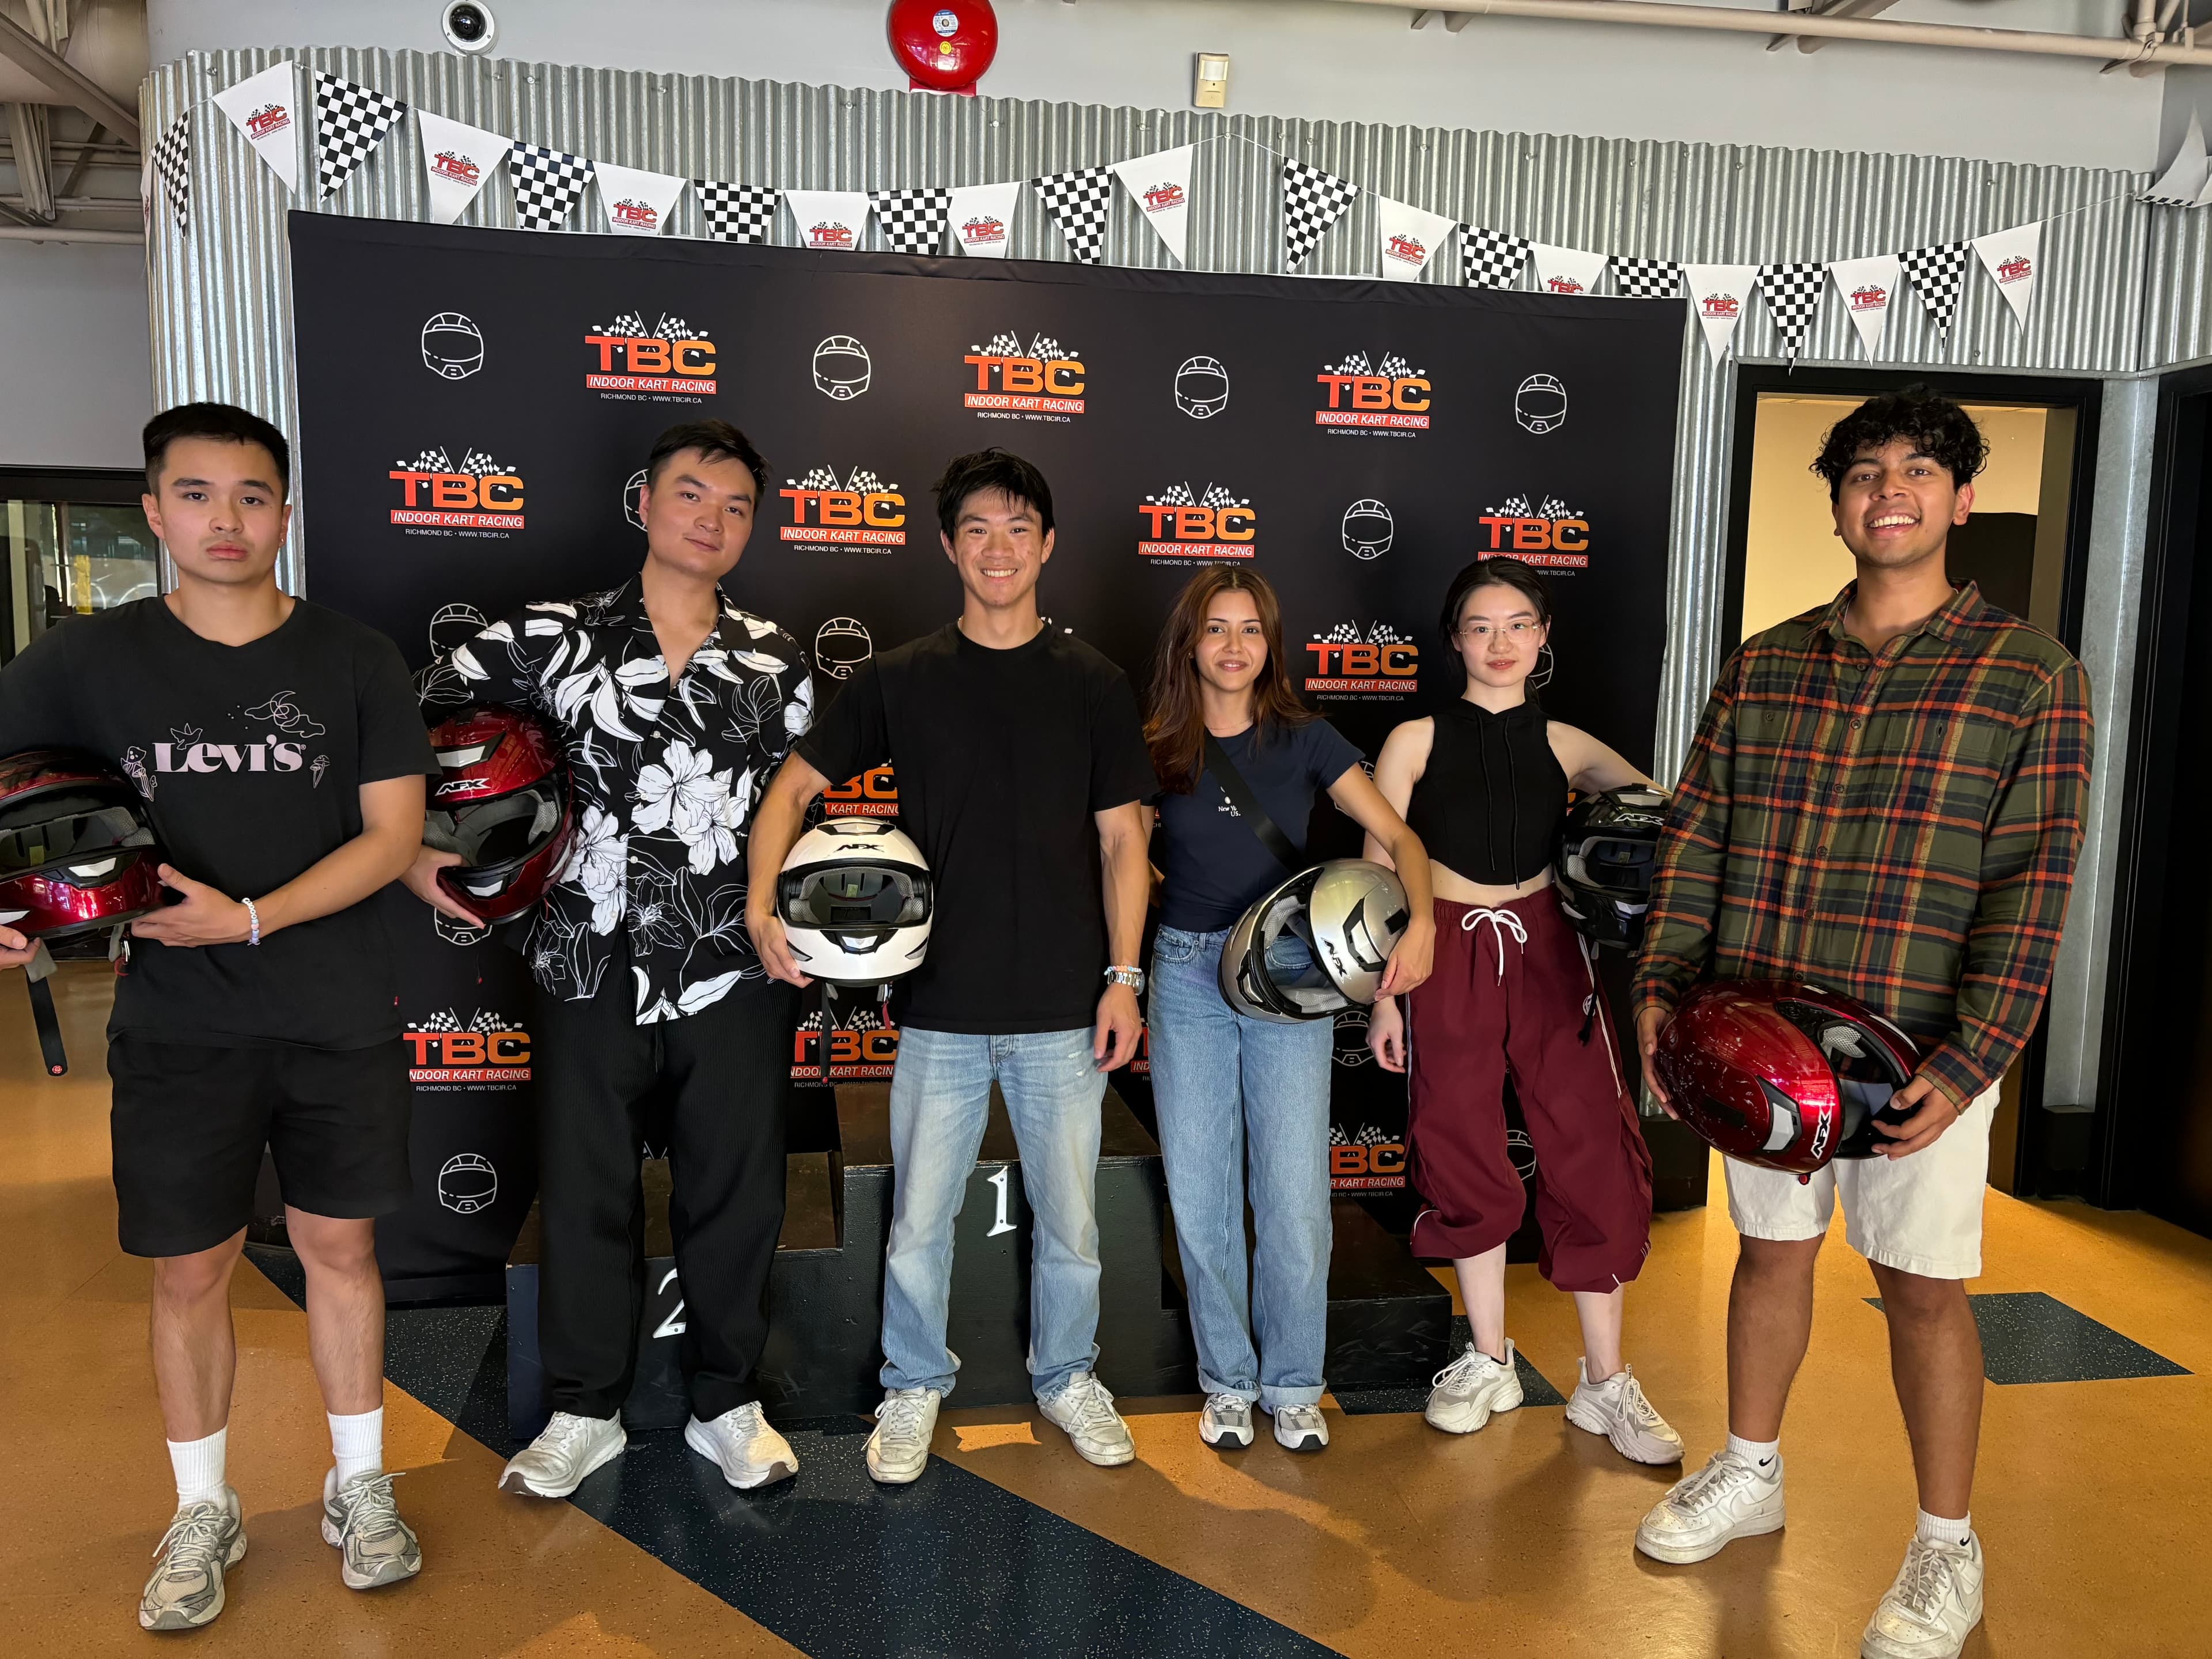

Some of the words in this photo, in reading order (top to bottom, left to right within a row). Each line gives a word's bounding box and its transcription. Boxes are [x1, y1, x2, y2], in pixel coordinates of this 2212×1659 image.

[246, 106, 287, 132] TBC
[434, 154, 479, 180] TBC
[1143, 187, 1183, 205] TBC
[613, 204, 657, 224] TBC
[809, 229, 852, 242] TBC
[962, 222, 1004, 237] TBC
[1389, 237, 1425, 259] TBC
[1997, 260, 2031, 277] TBC
[1850, 290, 1886, 304] TBC
[1703, 300, 1738, 312] TBC
[585, 336, 715, 376] TBC
[964, 355, 1085, 395] TBC
[589, 377, 634, 388] INDOOR
[638, 379, 668, 389] KART
[671, 381, 714, 392] RACING
[1317, 374, 1431, 411] TBC
[968, 396, 1009, 407] INDOOR
[1012, 397, 1041, 408] KART
[1043, 400, 1083, 411] RACING
[1025, 415, 1070, 423] WWW.TBCIR.CA
[1319, 413, 1358, 424] INDOOR
[1361, 415, 1388, 425] KART
[1390, 416, 1428, 426] RACING
[389, 471, 524, 510] TBC
[780, 488, 906, 527] TBC
[394, 512, 440, 523] INDOOR
[444, 514, 475, 525] KART
[478, 516, 522, 527] RACING
[1139, 505, 1256, 540] TBC
[783, 529, 827, 540] INDOOR
[830, 531, 860, 541] KART
[862, 532, 903, 543] RACING
[1479, 517, 1589, 551] TBC
[1141, 544, 1181, 554] INDOOR
[1184, 545, 1211, 555] KART
[1214, 546, 1252, 556] RACING
[1522, 555, 1548, 564] KART
[1550, 556, 1586, 565] RACING
[1306, 643, 1418, 675] TBC
[1308, 680, 1347, 689] INDOOR
[1350, 681, 1376, 690] KART
[1378, 681, 1415, 690] RACING
[824, 767, 897, 798] BC
[831, 804, 861, 813] KART
[403, 1032, 531, 1065] TBC
[410, 1071, 449, 1080] NDOOR
[453, 1070, 484, 1080] KART
[486, 1069, 529, 1080] RACING
[790, 1067, 821, 1077] NDOO
[830, 1067, 858, 1076] KART
[861, 1067, 893, 1075] RACIN
[1331, 1144, 1405, 1174] BC
[1339, 1179, 1366, 1187] KART
[1368, 1177, 1403, 1186] RACING
[986, 1166, 1017, 1237] 1
[653, 1267, 687, 1338] 2
